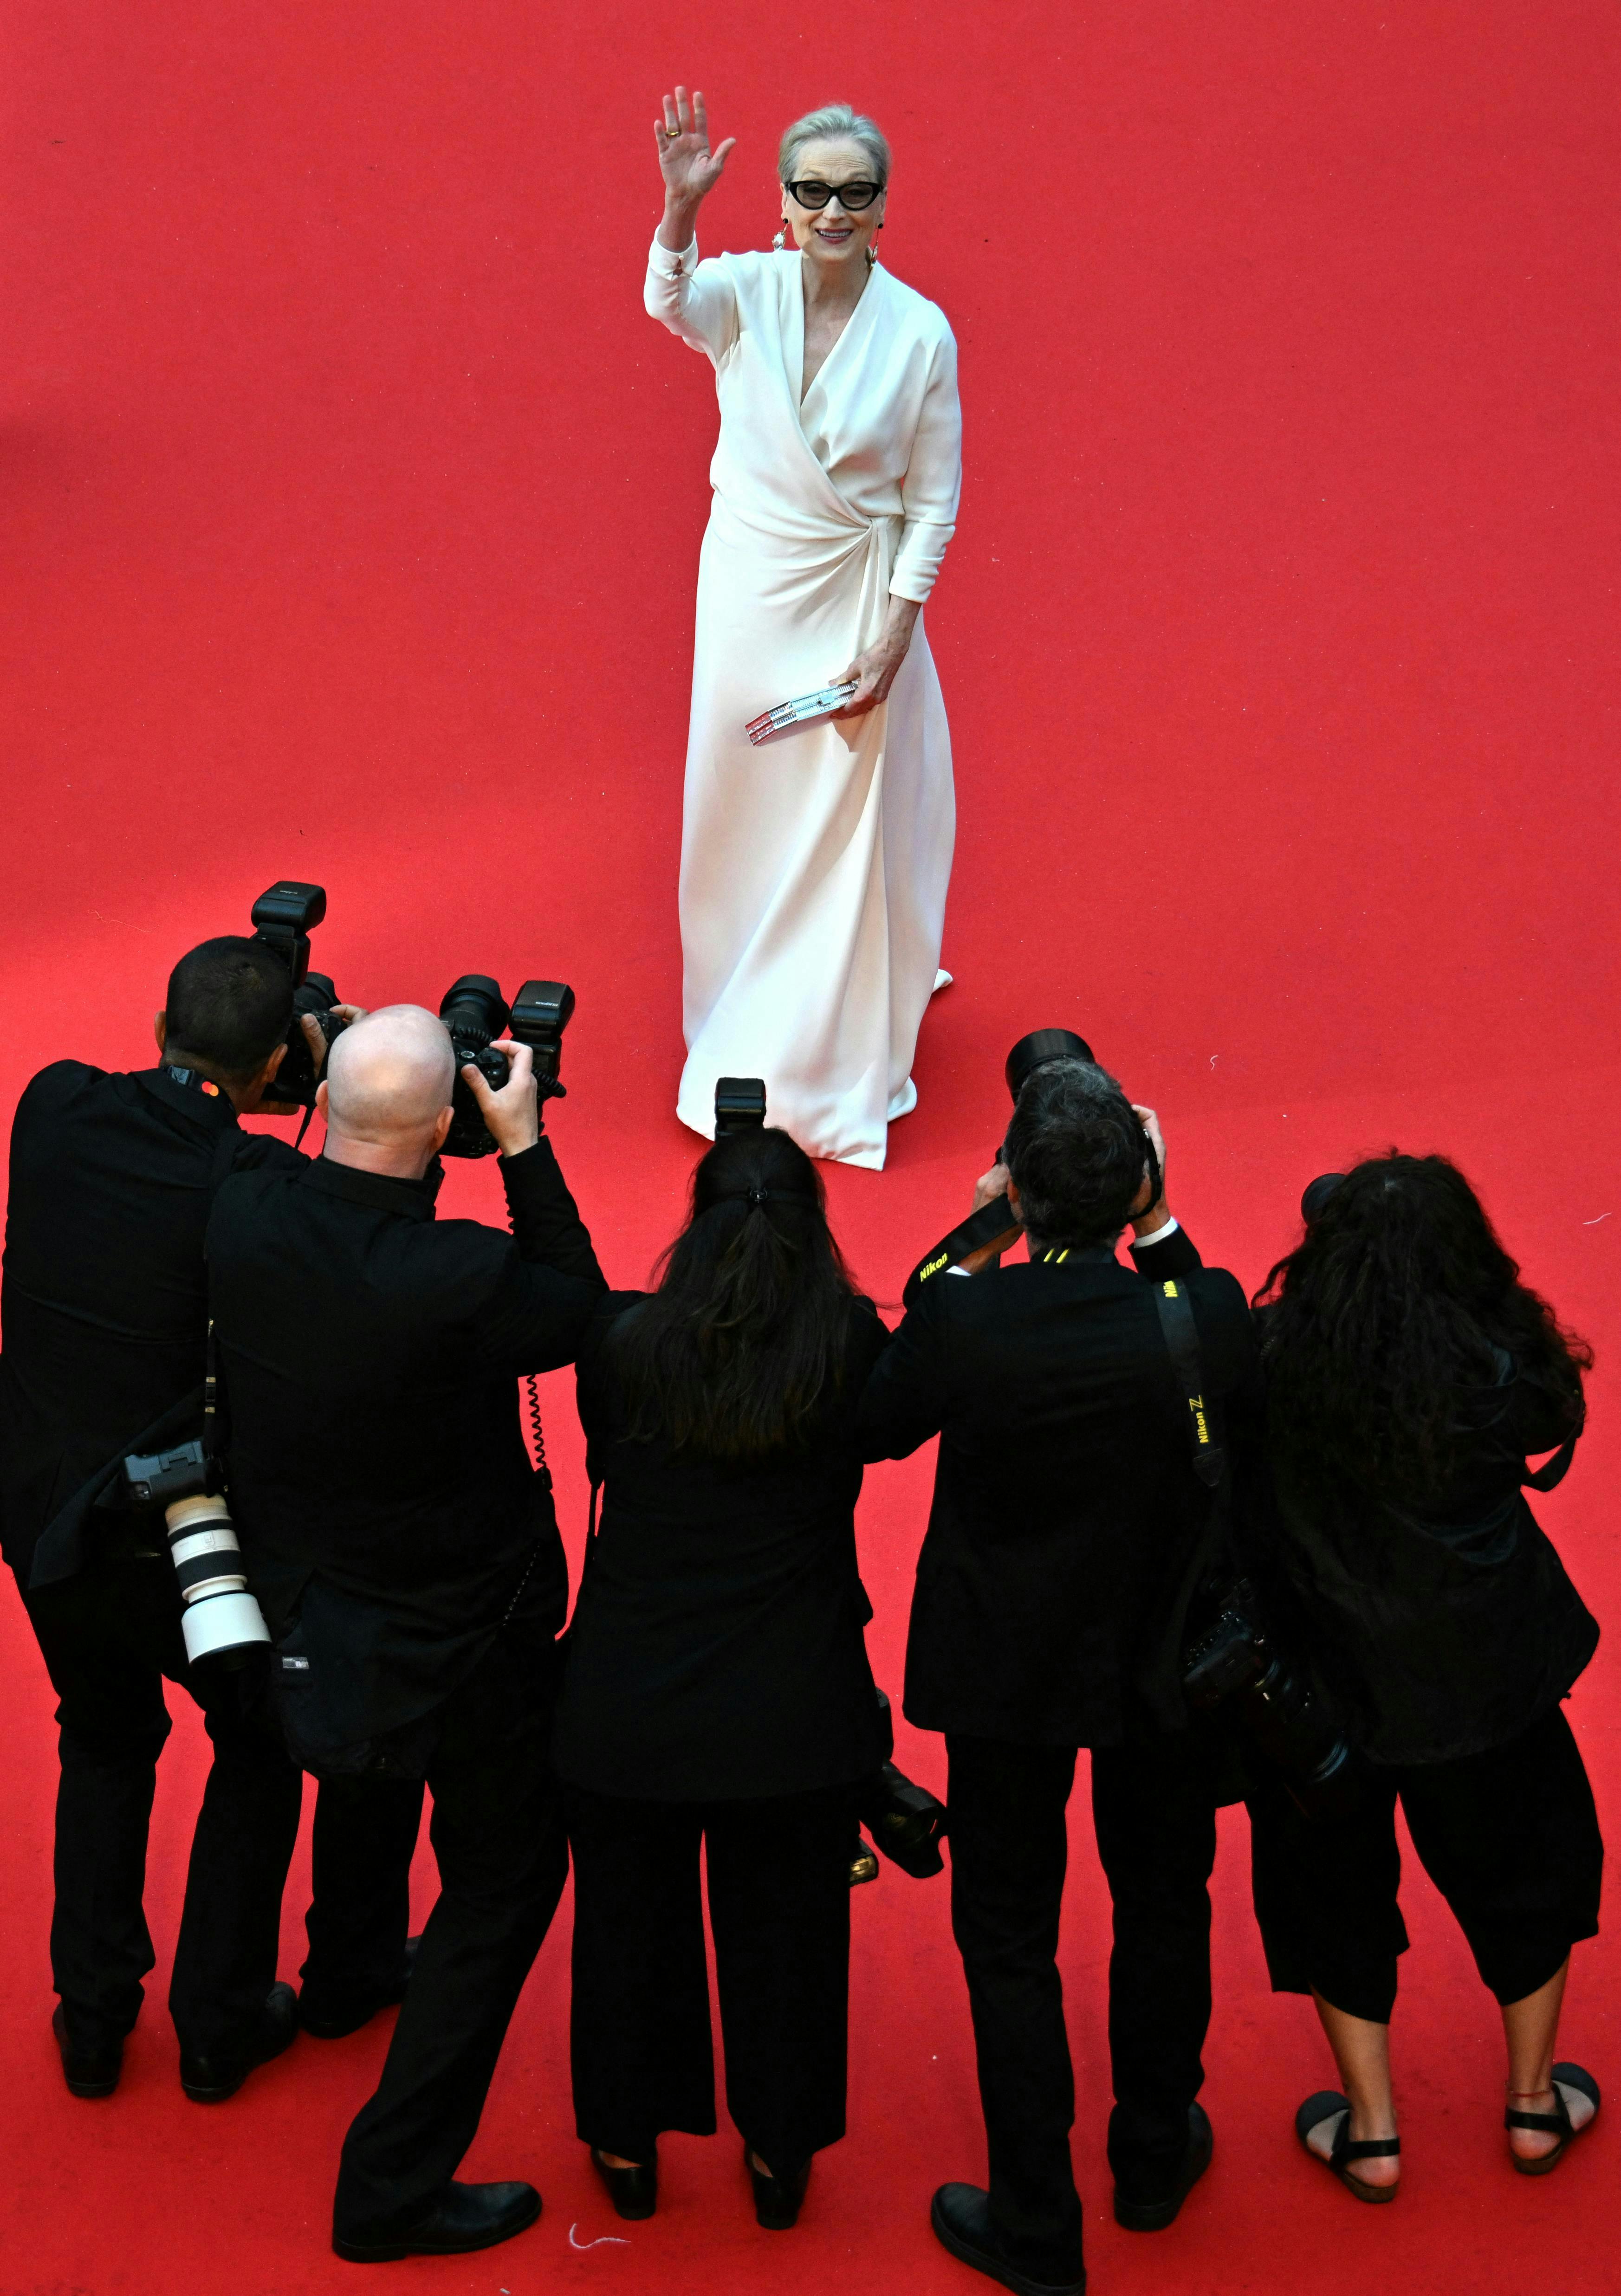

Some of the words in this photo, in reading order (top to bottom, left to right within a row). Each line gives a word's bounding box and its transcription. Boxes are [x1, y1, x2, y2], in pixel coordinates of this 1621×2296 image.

[920, 1253, 948, 1282] Nikon
[1163, 1280, 1178, 1297] Nik
[1189, 1395, 1203, 1411] Z
[1196, 1412, 1209, 1443] Nikon
